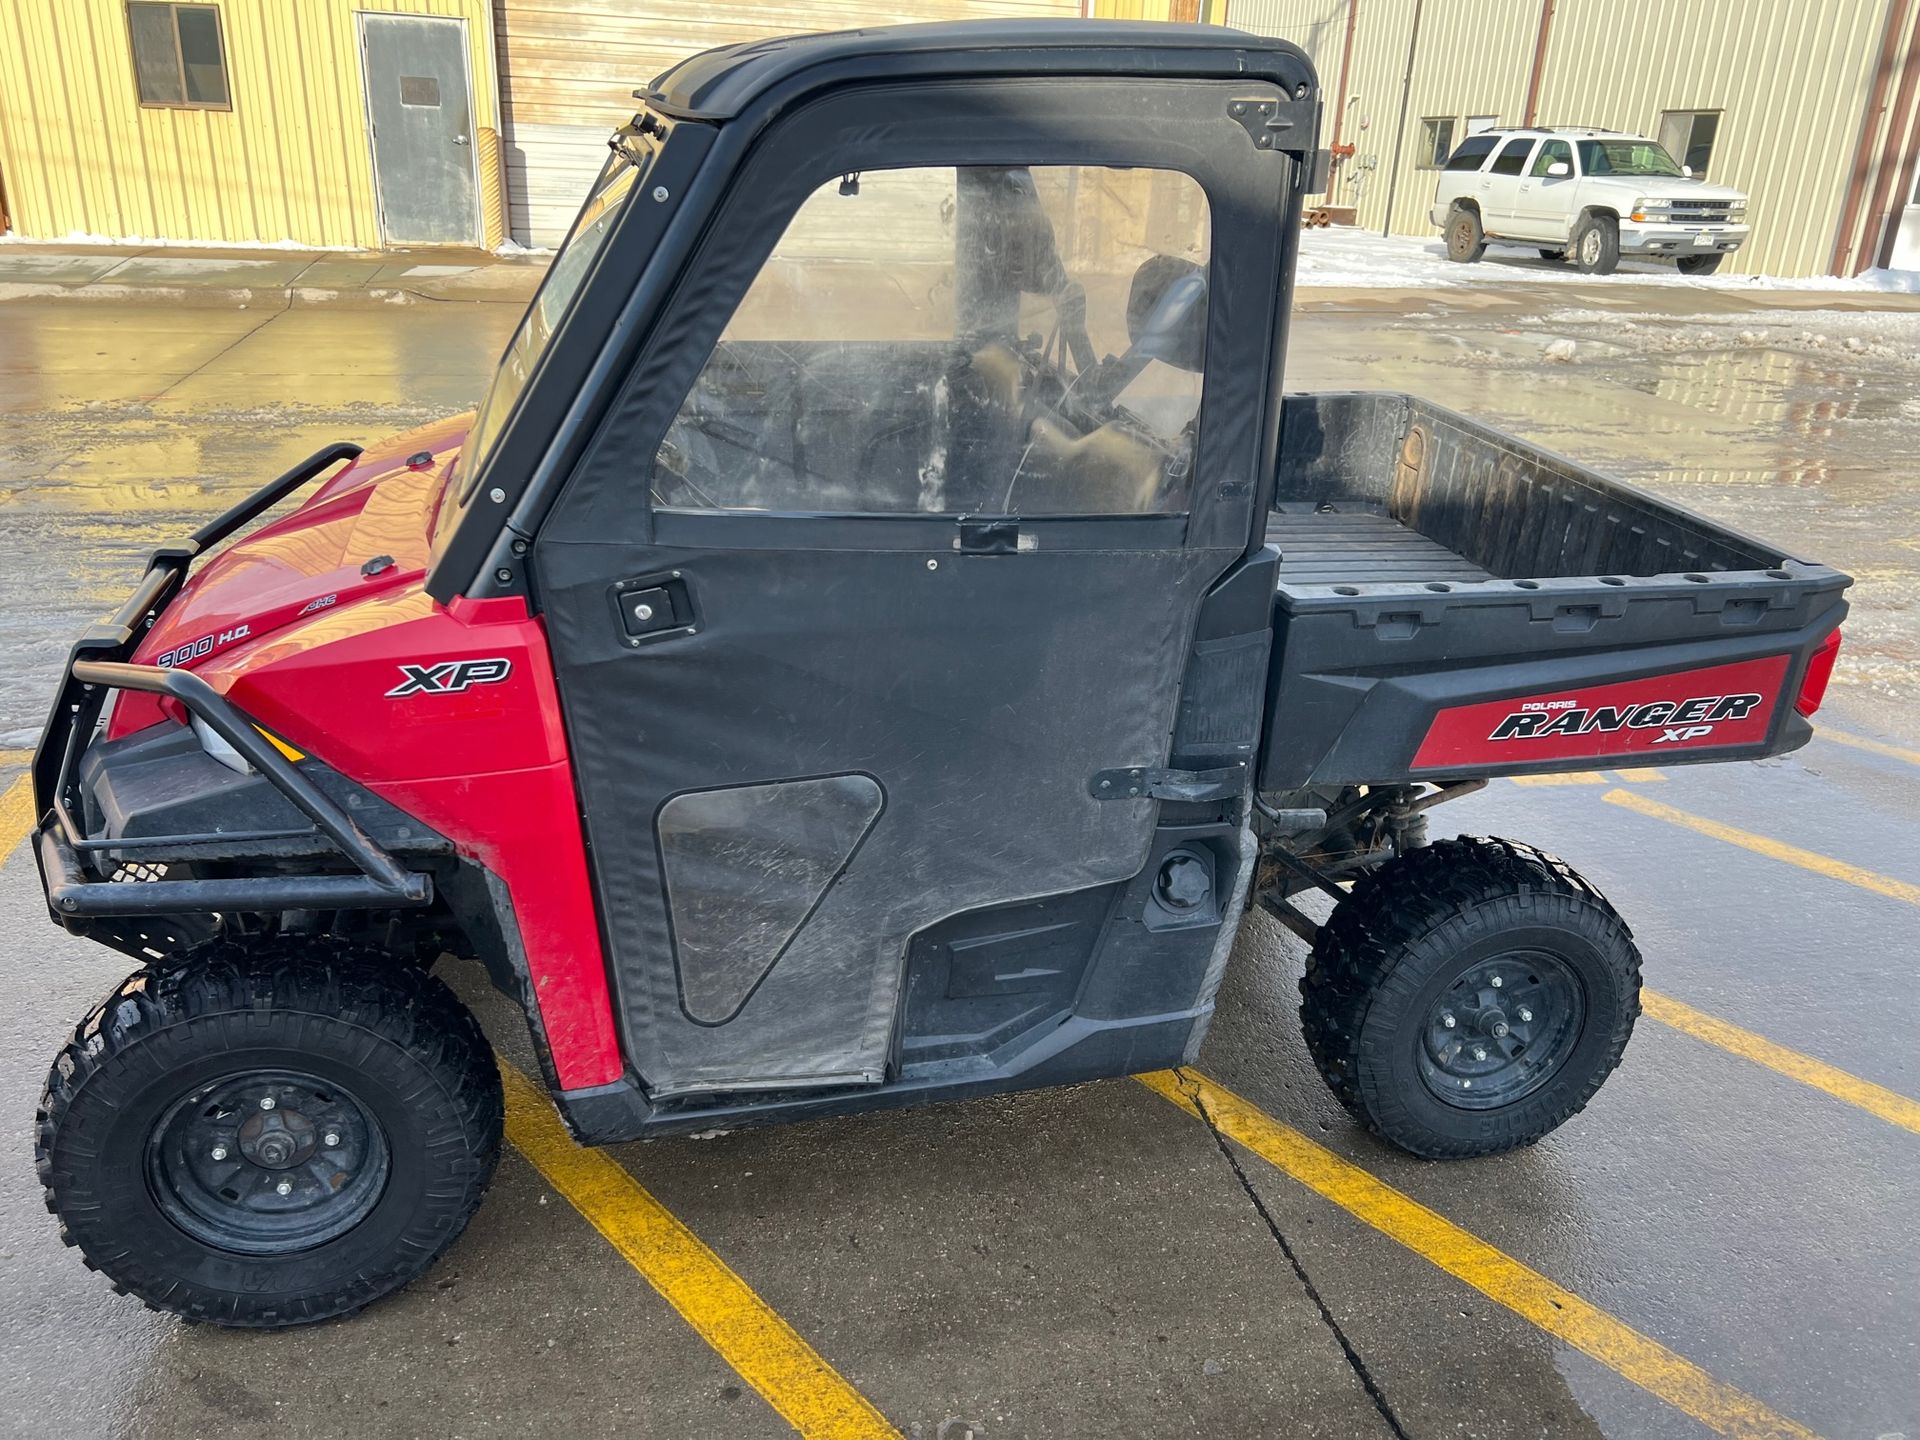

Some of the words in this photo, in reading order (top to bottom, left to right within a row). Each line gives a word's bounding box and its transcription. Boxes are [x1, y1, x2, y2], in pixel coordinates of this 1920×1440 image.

[157, 634, 214, 668] 900
[384, 658, 511, 696] XP
[1487, 693, 1762, 741] RANGER
[1521, 700, 1577, 712] POLARIS
[1648, 725, 1713, 744] XP
